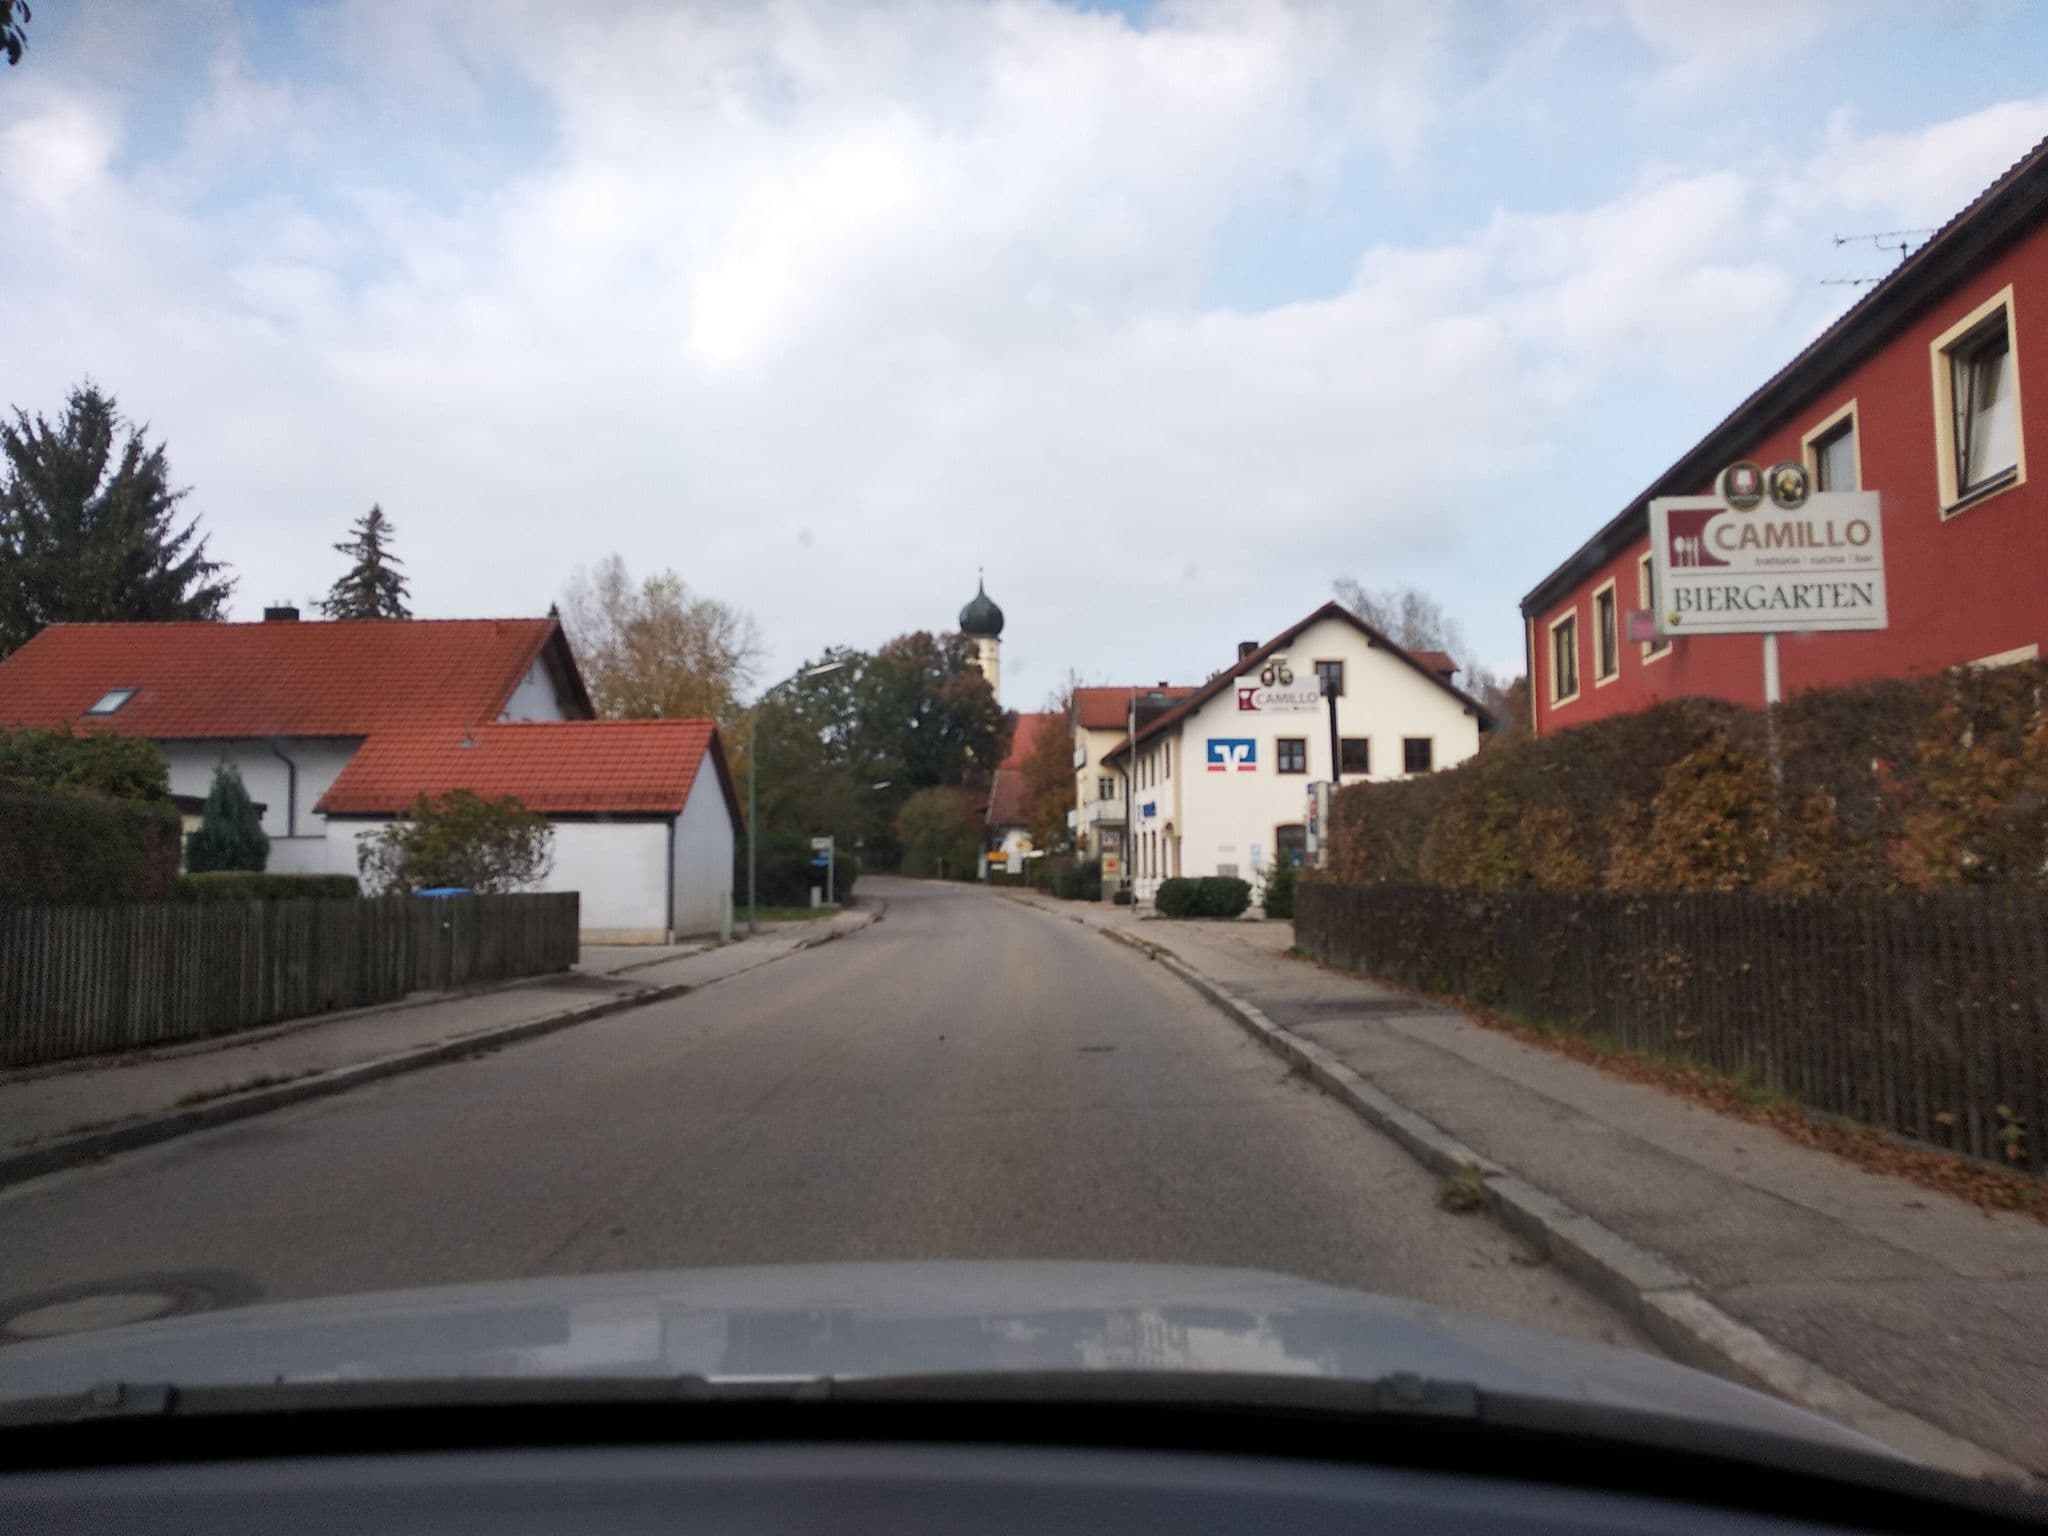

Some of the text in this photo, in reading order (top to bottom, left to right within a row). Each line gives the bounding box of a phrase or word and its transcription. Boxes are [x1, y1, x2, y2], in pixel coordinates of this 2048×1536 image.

[1714, 519, 1872, 551] CAMILLO
[1674, 582, 1873, 613] BIERGARTEN
[1255, 692, 1319, 705] CAMILLO
